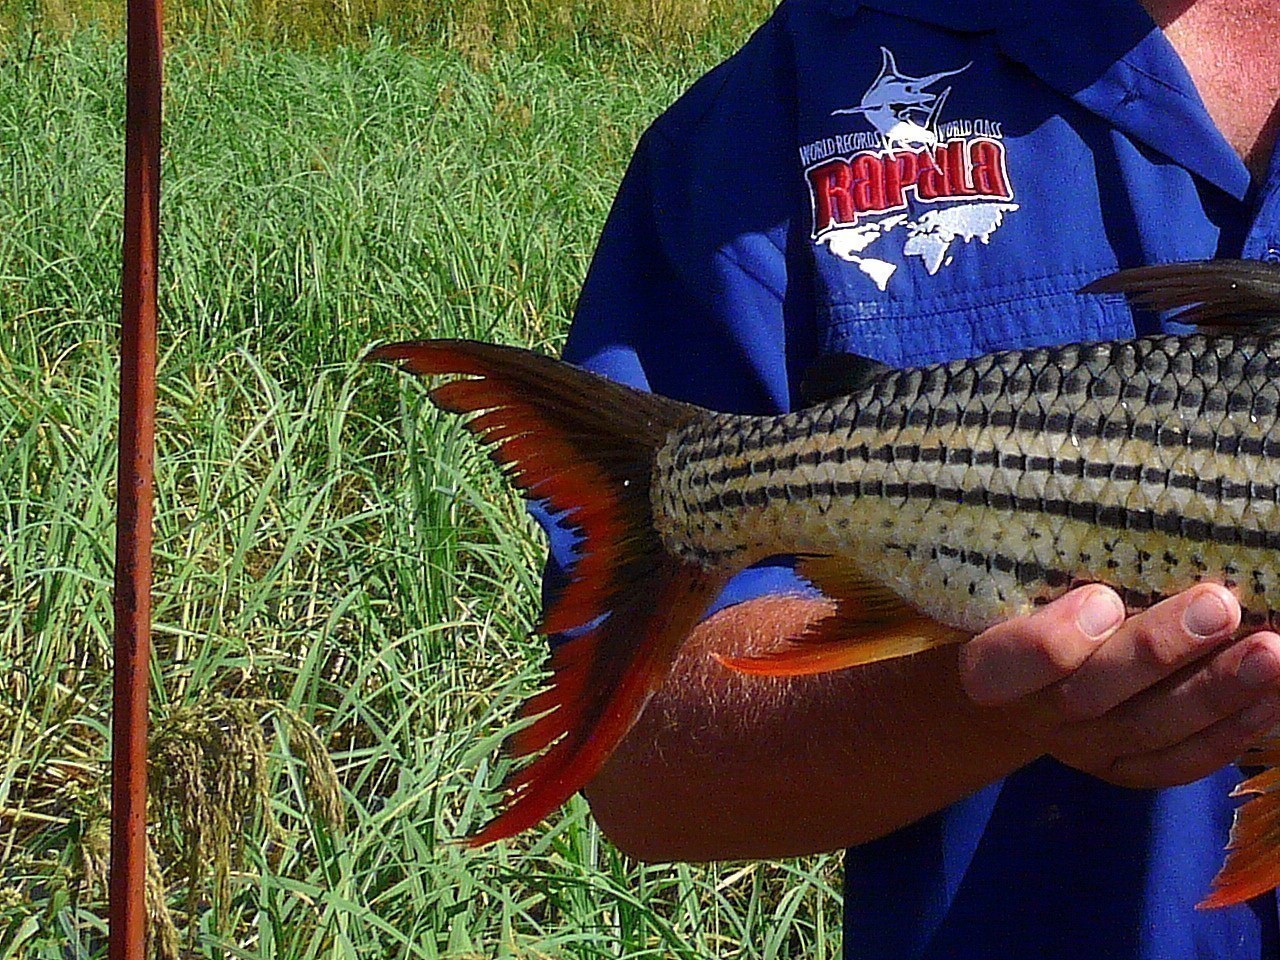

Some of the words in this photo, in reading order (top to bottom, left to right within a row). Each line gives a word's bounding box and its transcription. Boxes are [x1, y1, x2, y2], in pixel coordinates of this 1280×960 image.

[799, 138, 835, 166] WORLD
[835, 131, 881, 154] RECORDS
[938, 119, 972, 142] WORLD
[974, 119, 1003, 139] CLASS
